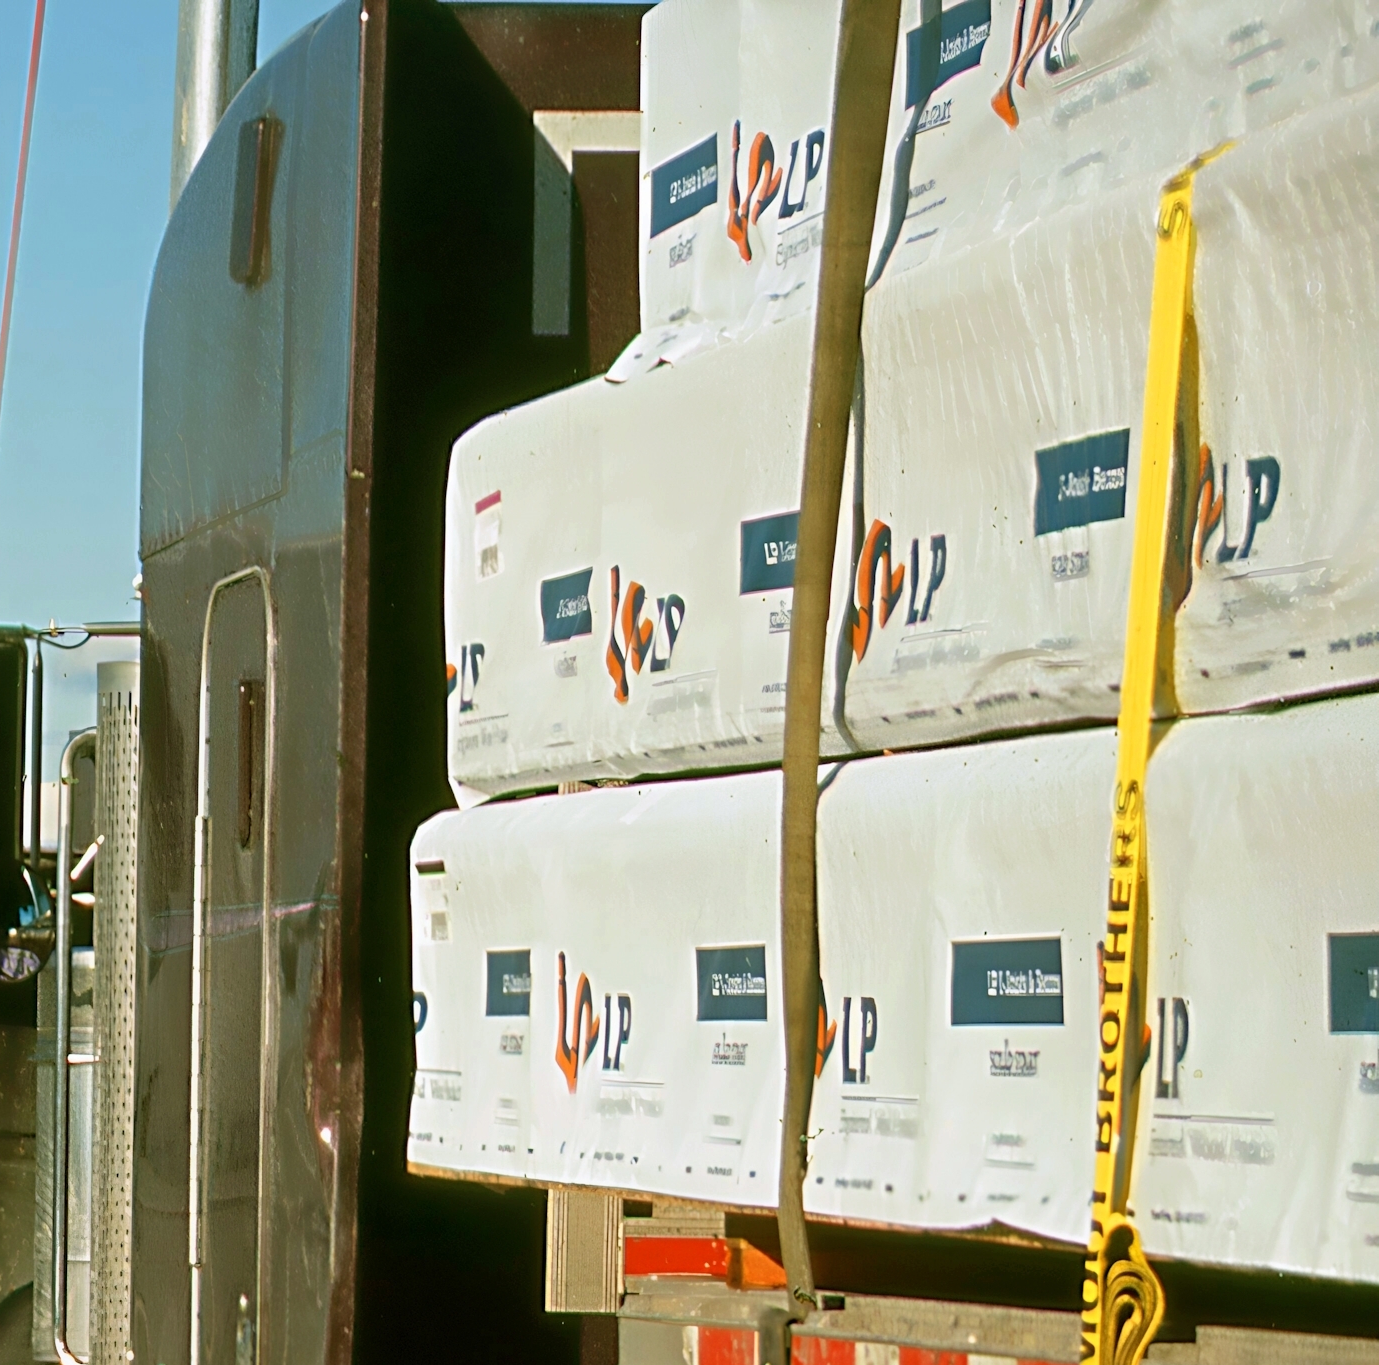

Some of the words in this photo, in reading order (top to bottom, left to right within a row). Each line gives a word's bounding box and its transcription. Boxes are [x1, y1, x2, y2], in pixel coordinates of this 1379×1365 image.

[778, 128, 825, 219] LP
[1217, 455, 1280, 563] LP
[905, 533, 947, 626] LP
[460, 643, 485, 712] LP
[650, 594, 685, 673] LP
[602, 993, 632, 1071] LP
[842, 997, 877, 1084] LP
[1155, 997, 1189, 1098] LP
